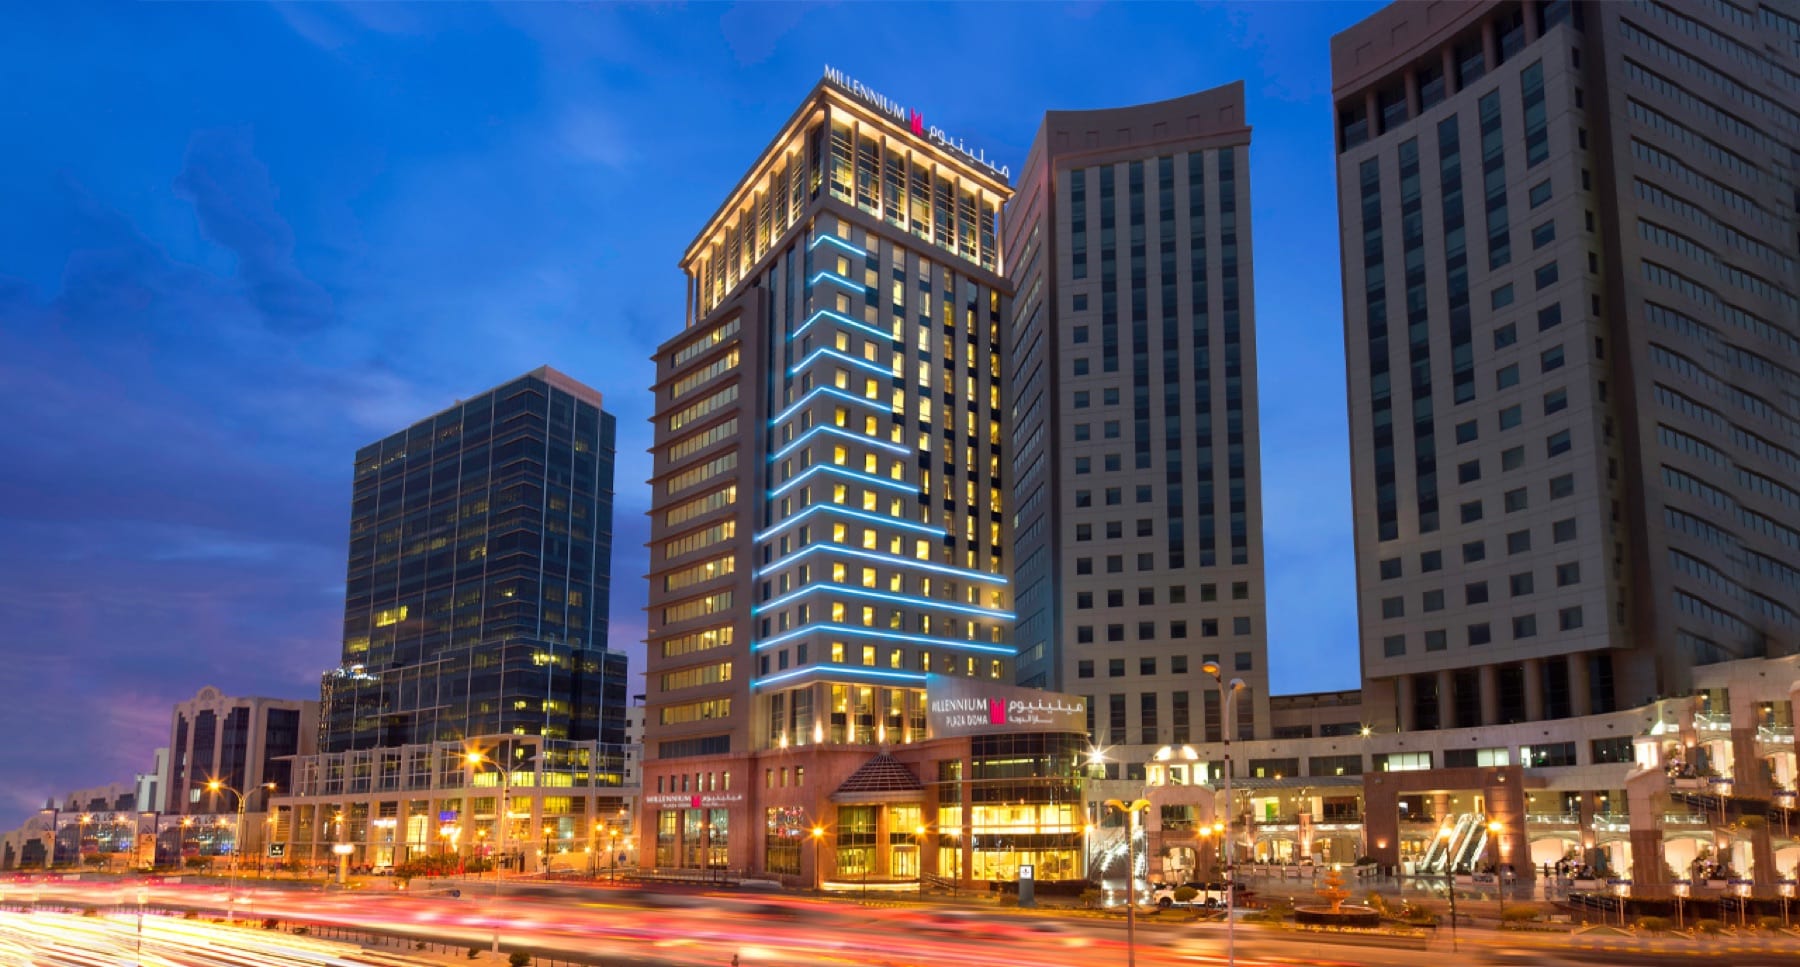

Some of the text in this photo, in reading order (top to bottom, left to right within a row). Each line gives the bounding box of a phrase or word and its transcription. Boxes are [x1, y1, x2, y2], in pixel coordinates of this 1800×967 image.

[824, 64, 905, 122] MILLENNIUM
[928, 125, 1009, 178] ميلينيوم
[931, 698, 987, 712] MILLENNIUM
[1008, 699, 1083, 714] ميلينيوم
